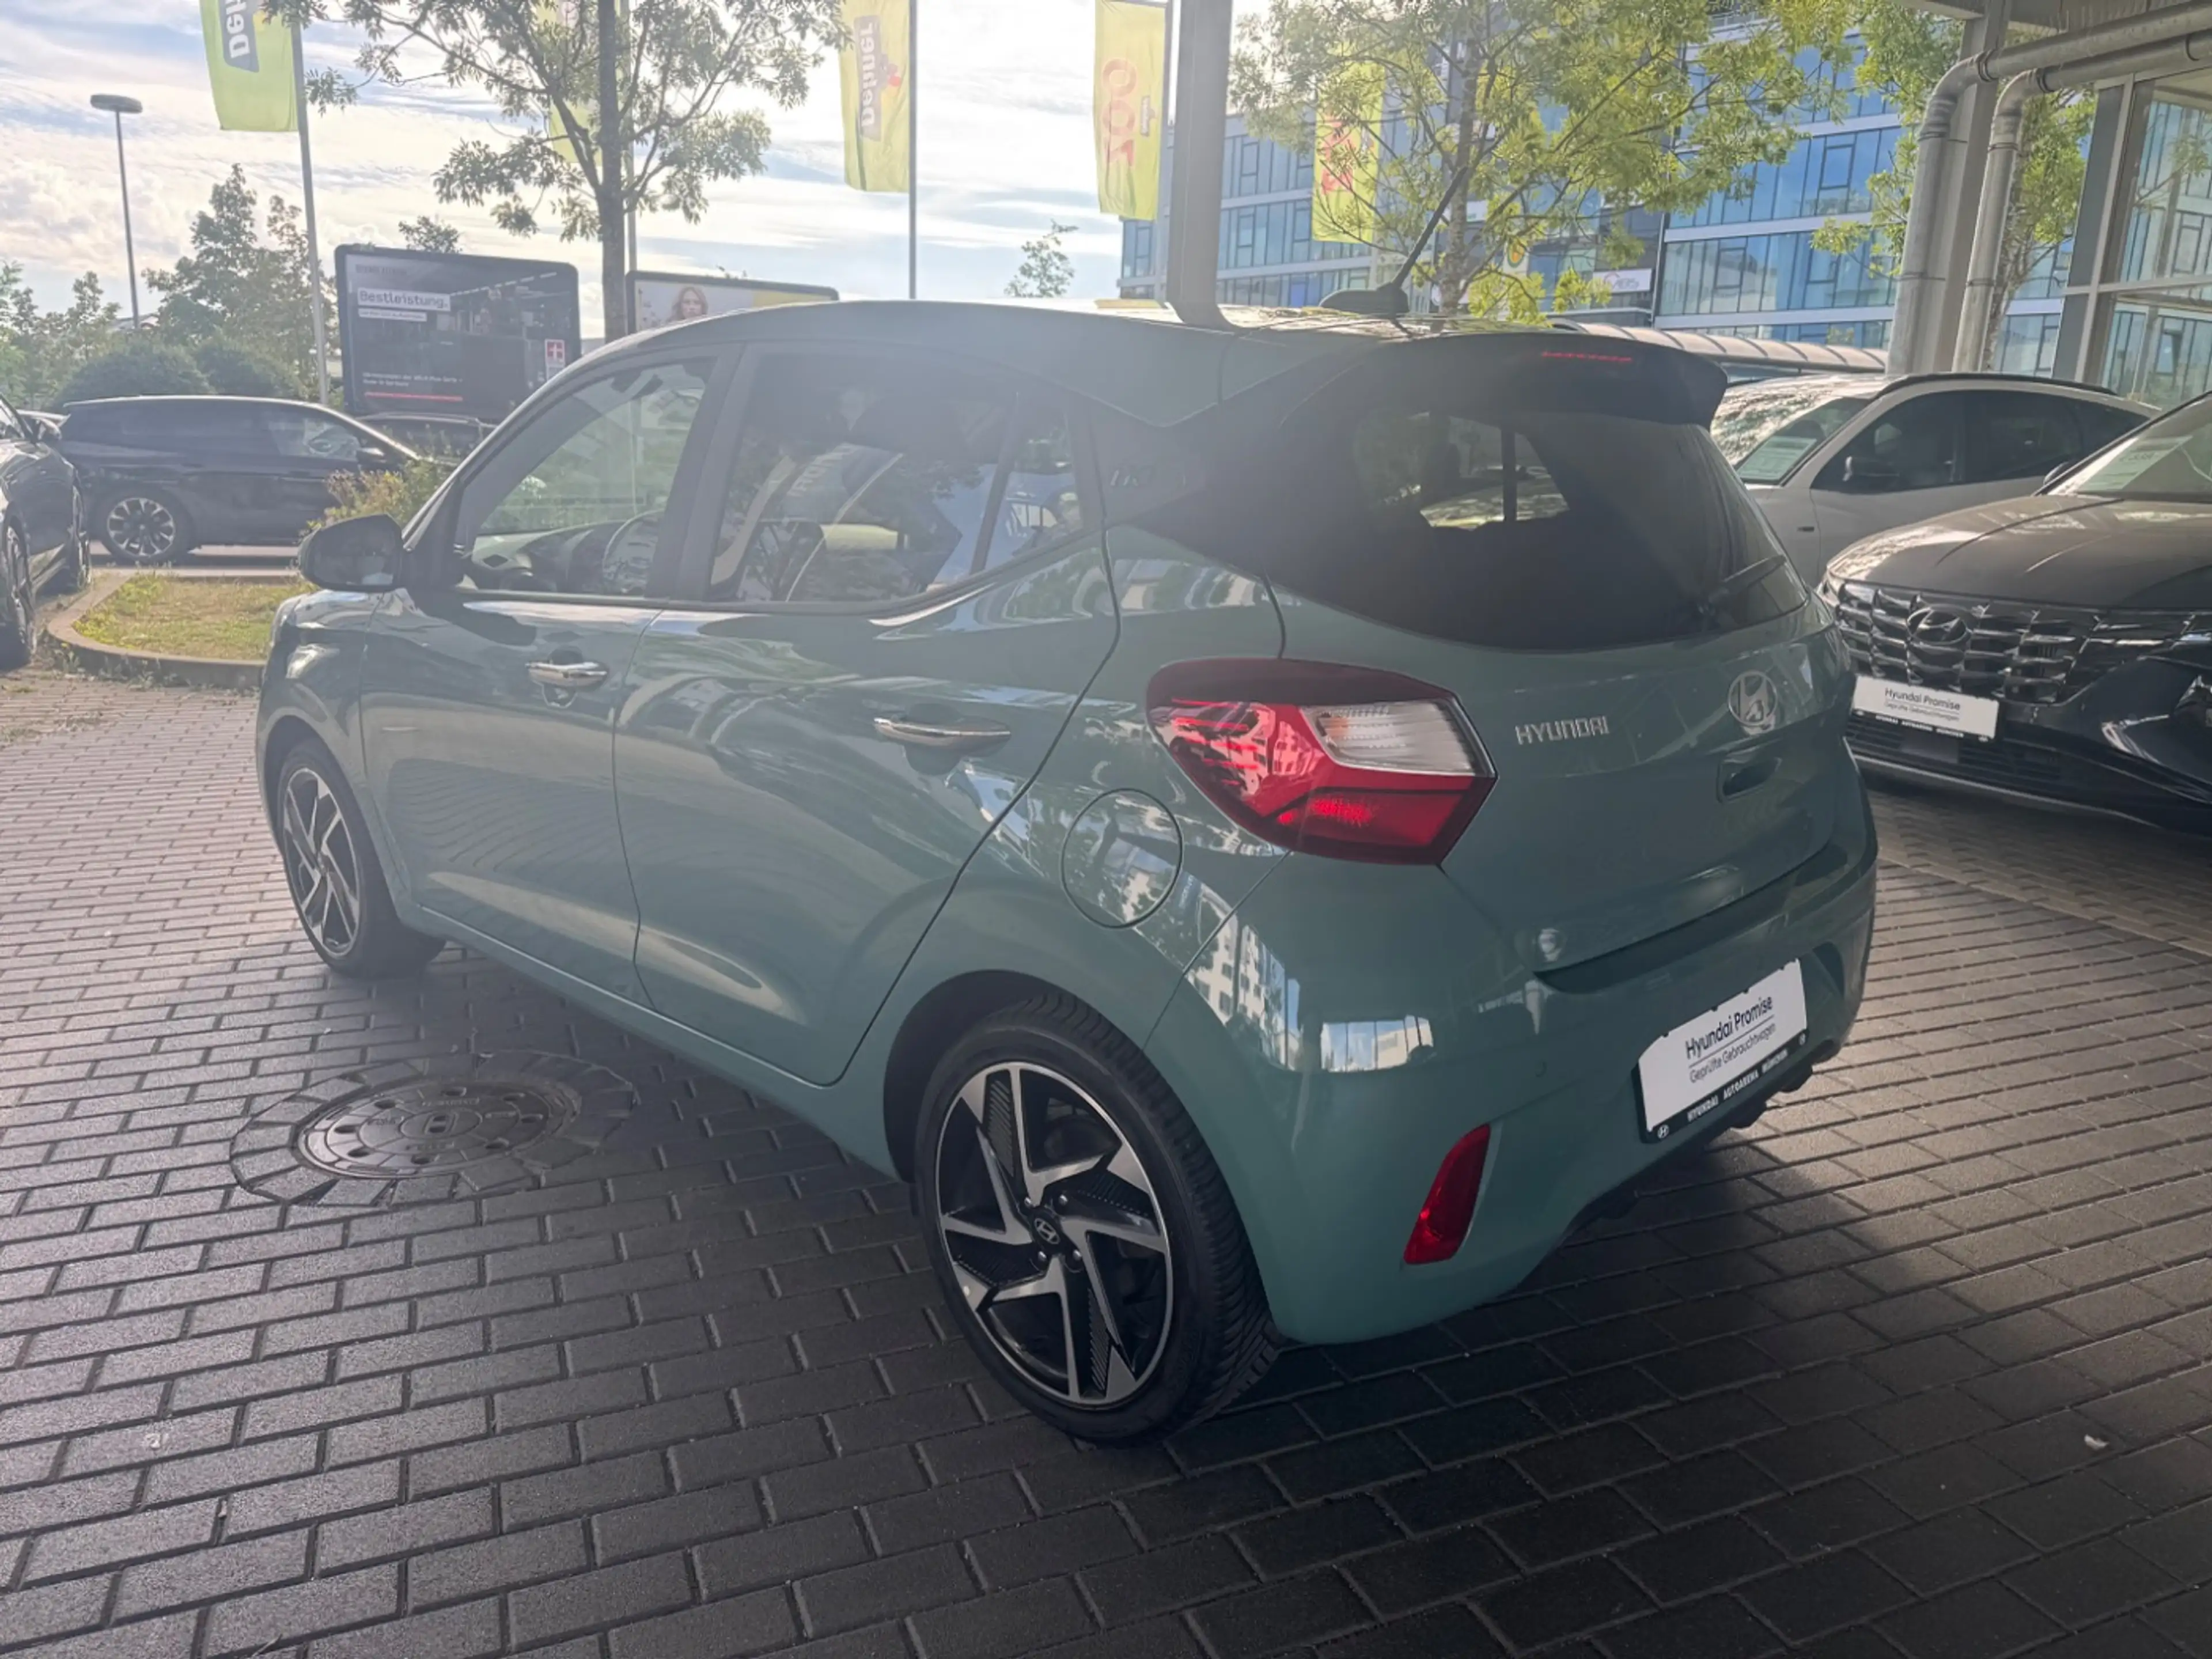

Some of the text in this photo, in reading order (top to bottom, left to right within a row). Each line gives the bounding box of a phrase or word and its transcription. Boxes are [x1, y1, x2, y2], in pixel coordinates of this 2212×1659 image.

[359, 290, 448, 309] Bestleistung.
[1885, 687, 1960, 710] Hyundai Promise
[1514, 715, 1610, 745] HYUNDAI
[1685, 996, 1773, 1060] Hyundai Promise
[1689, 1055, 1722, 1084] Geprüfte
[1687, 1095, 1719, 1122] HYUNDAI
